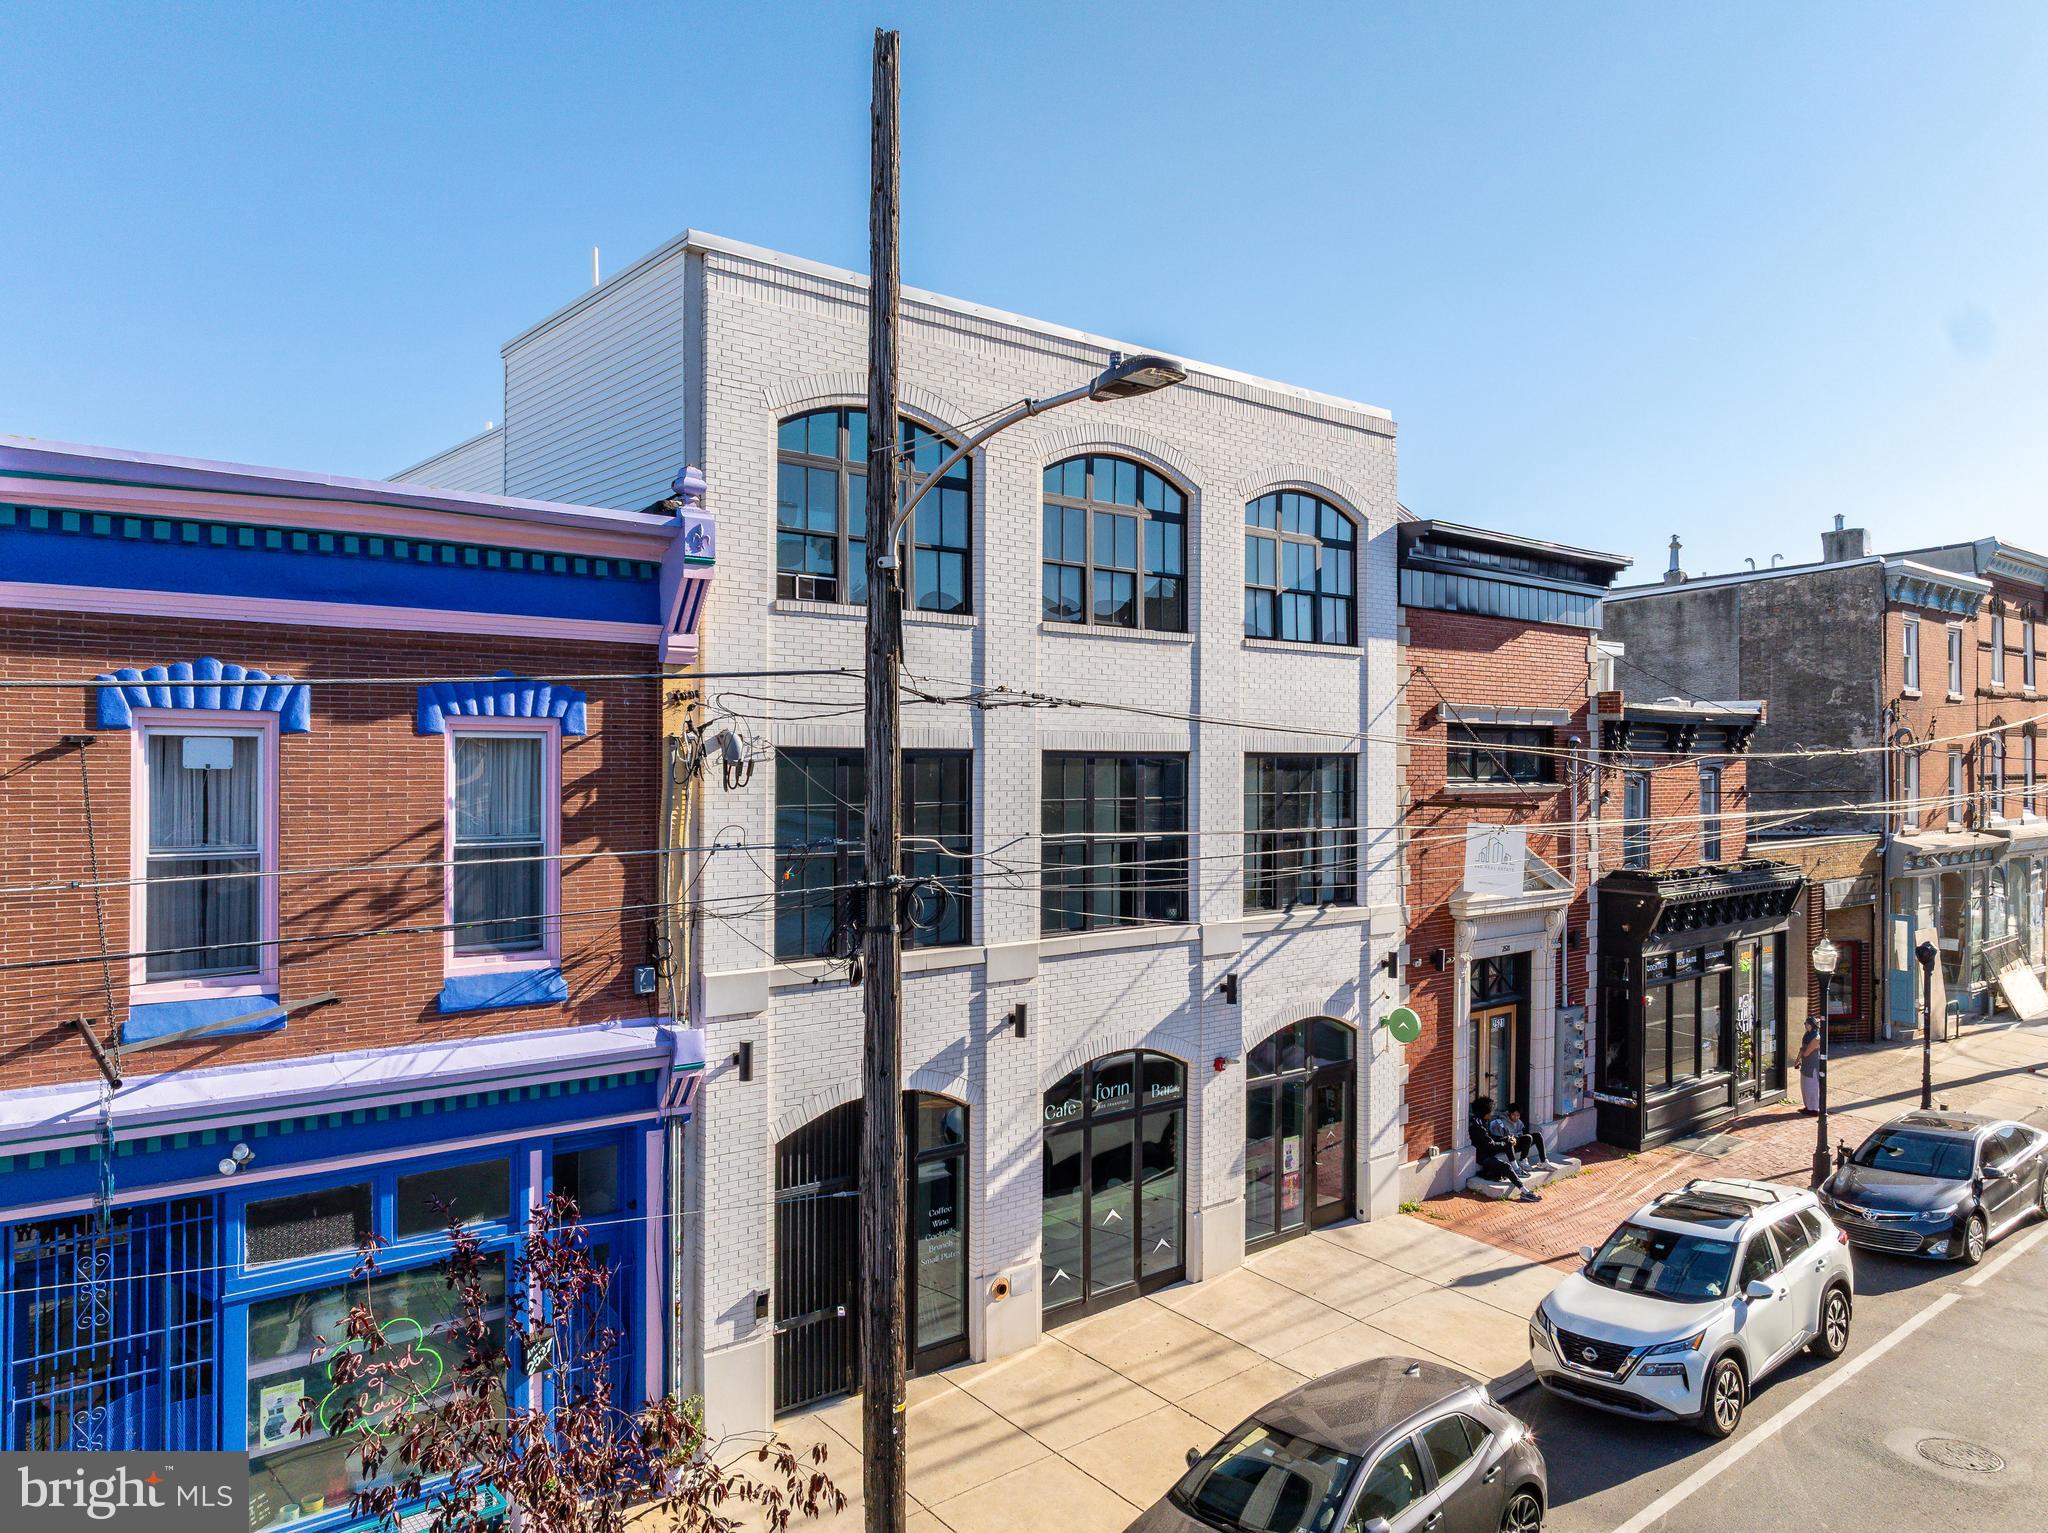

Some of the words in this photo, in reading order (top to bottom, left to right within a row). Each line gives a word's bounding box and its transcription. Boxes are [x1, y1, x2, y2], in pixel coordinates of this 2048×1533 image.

[1096, 1082, 1130, 1101] forin
[1044, 1101, 1077, 1120] Cafe
[928, 1206, 953, 1218] Coffee
[932, 1218, 950, 1228] Wine
[925, 1227, 957, 1242] Cocktails
[928, 1240, 953, 1253] Brunch
[920, 1254, 940, 1266] Small
[940, 1250, 961, 1261] Plates
[353, 1391, 411, 1417] lay
